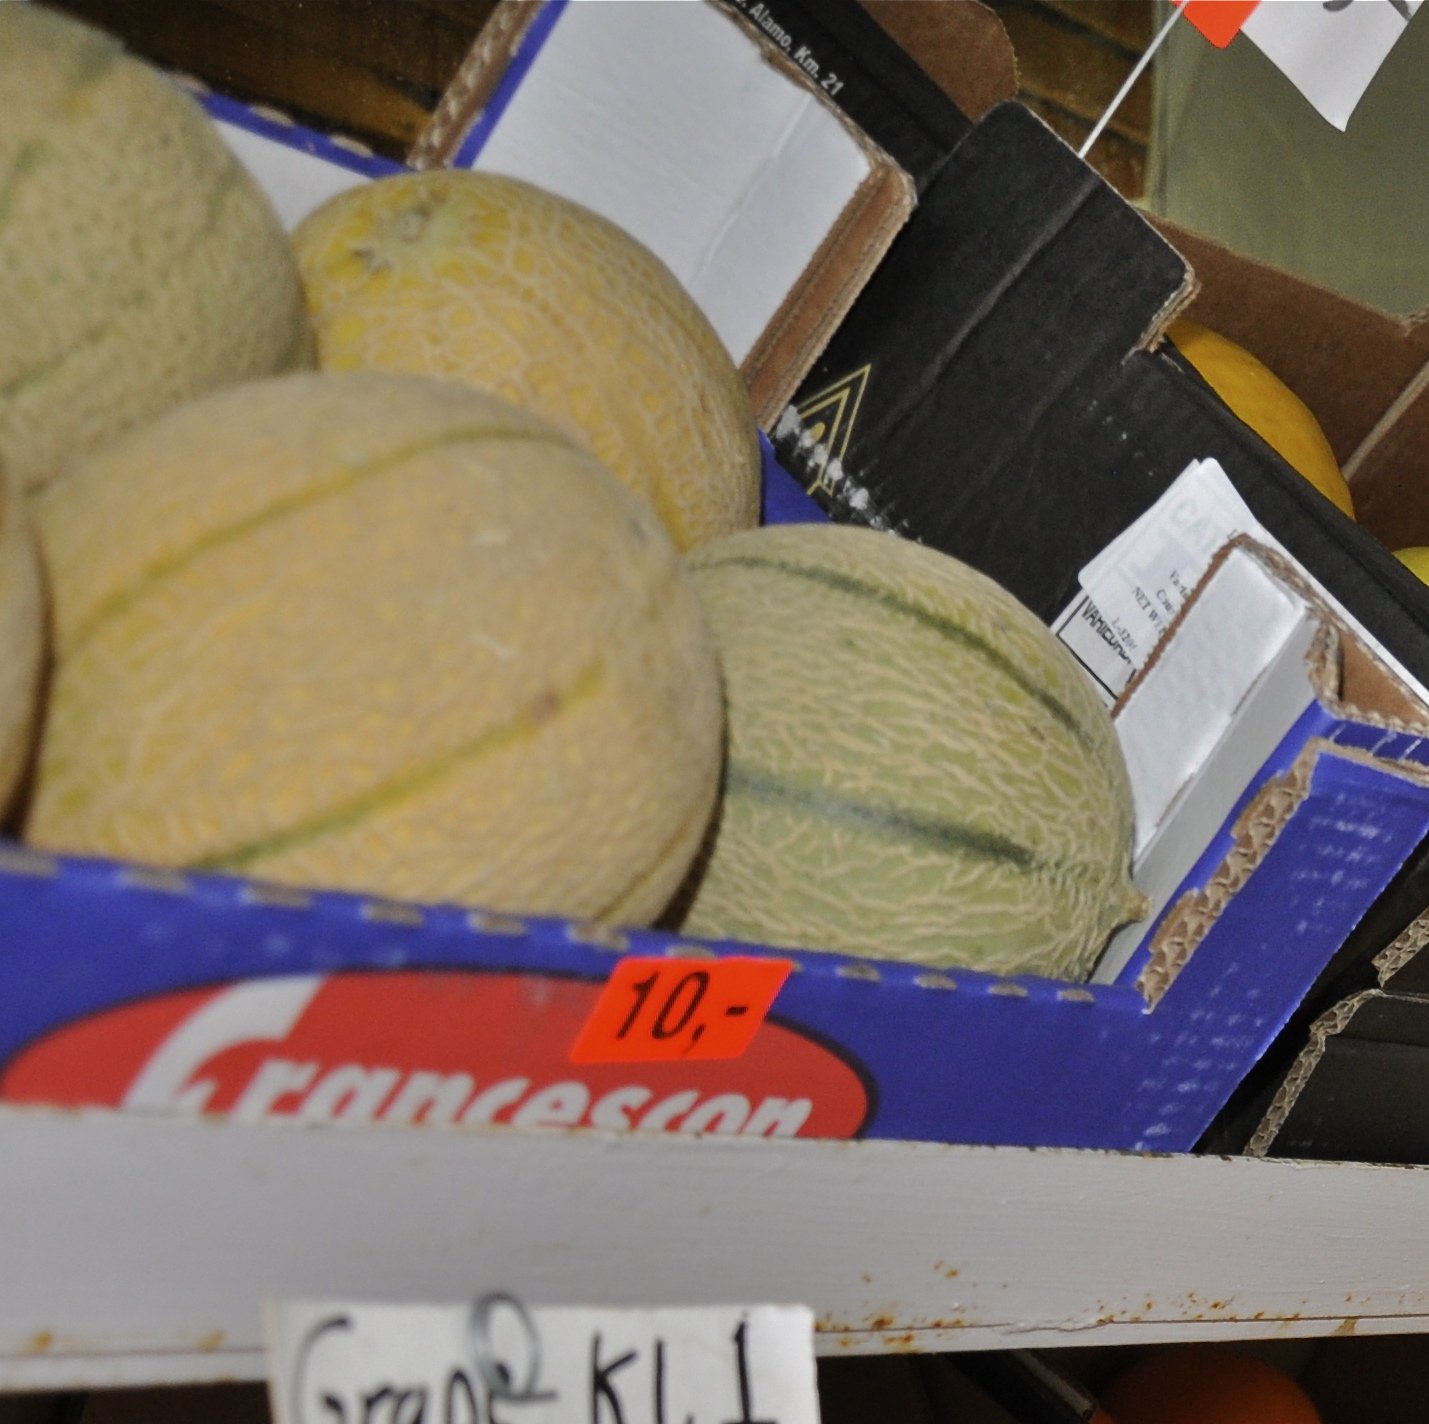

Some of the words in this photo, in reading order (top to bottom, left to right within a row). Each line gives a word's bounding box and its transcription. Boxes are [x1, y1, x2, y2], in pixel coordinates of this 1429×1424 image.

[749, 3, 791, 52] Alamo,
[794, 46, 819, 78] Km.
[821, 73, 844, 96] 21
[614, 969, 751, 1045] 10,-
